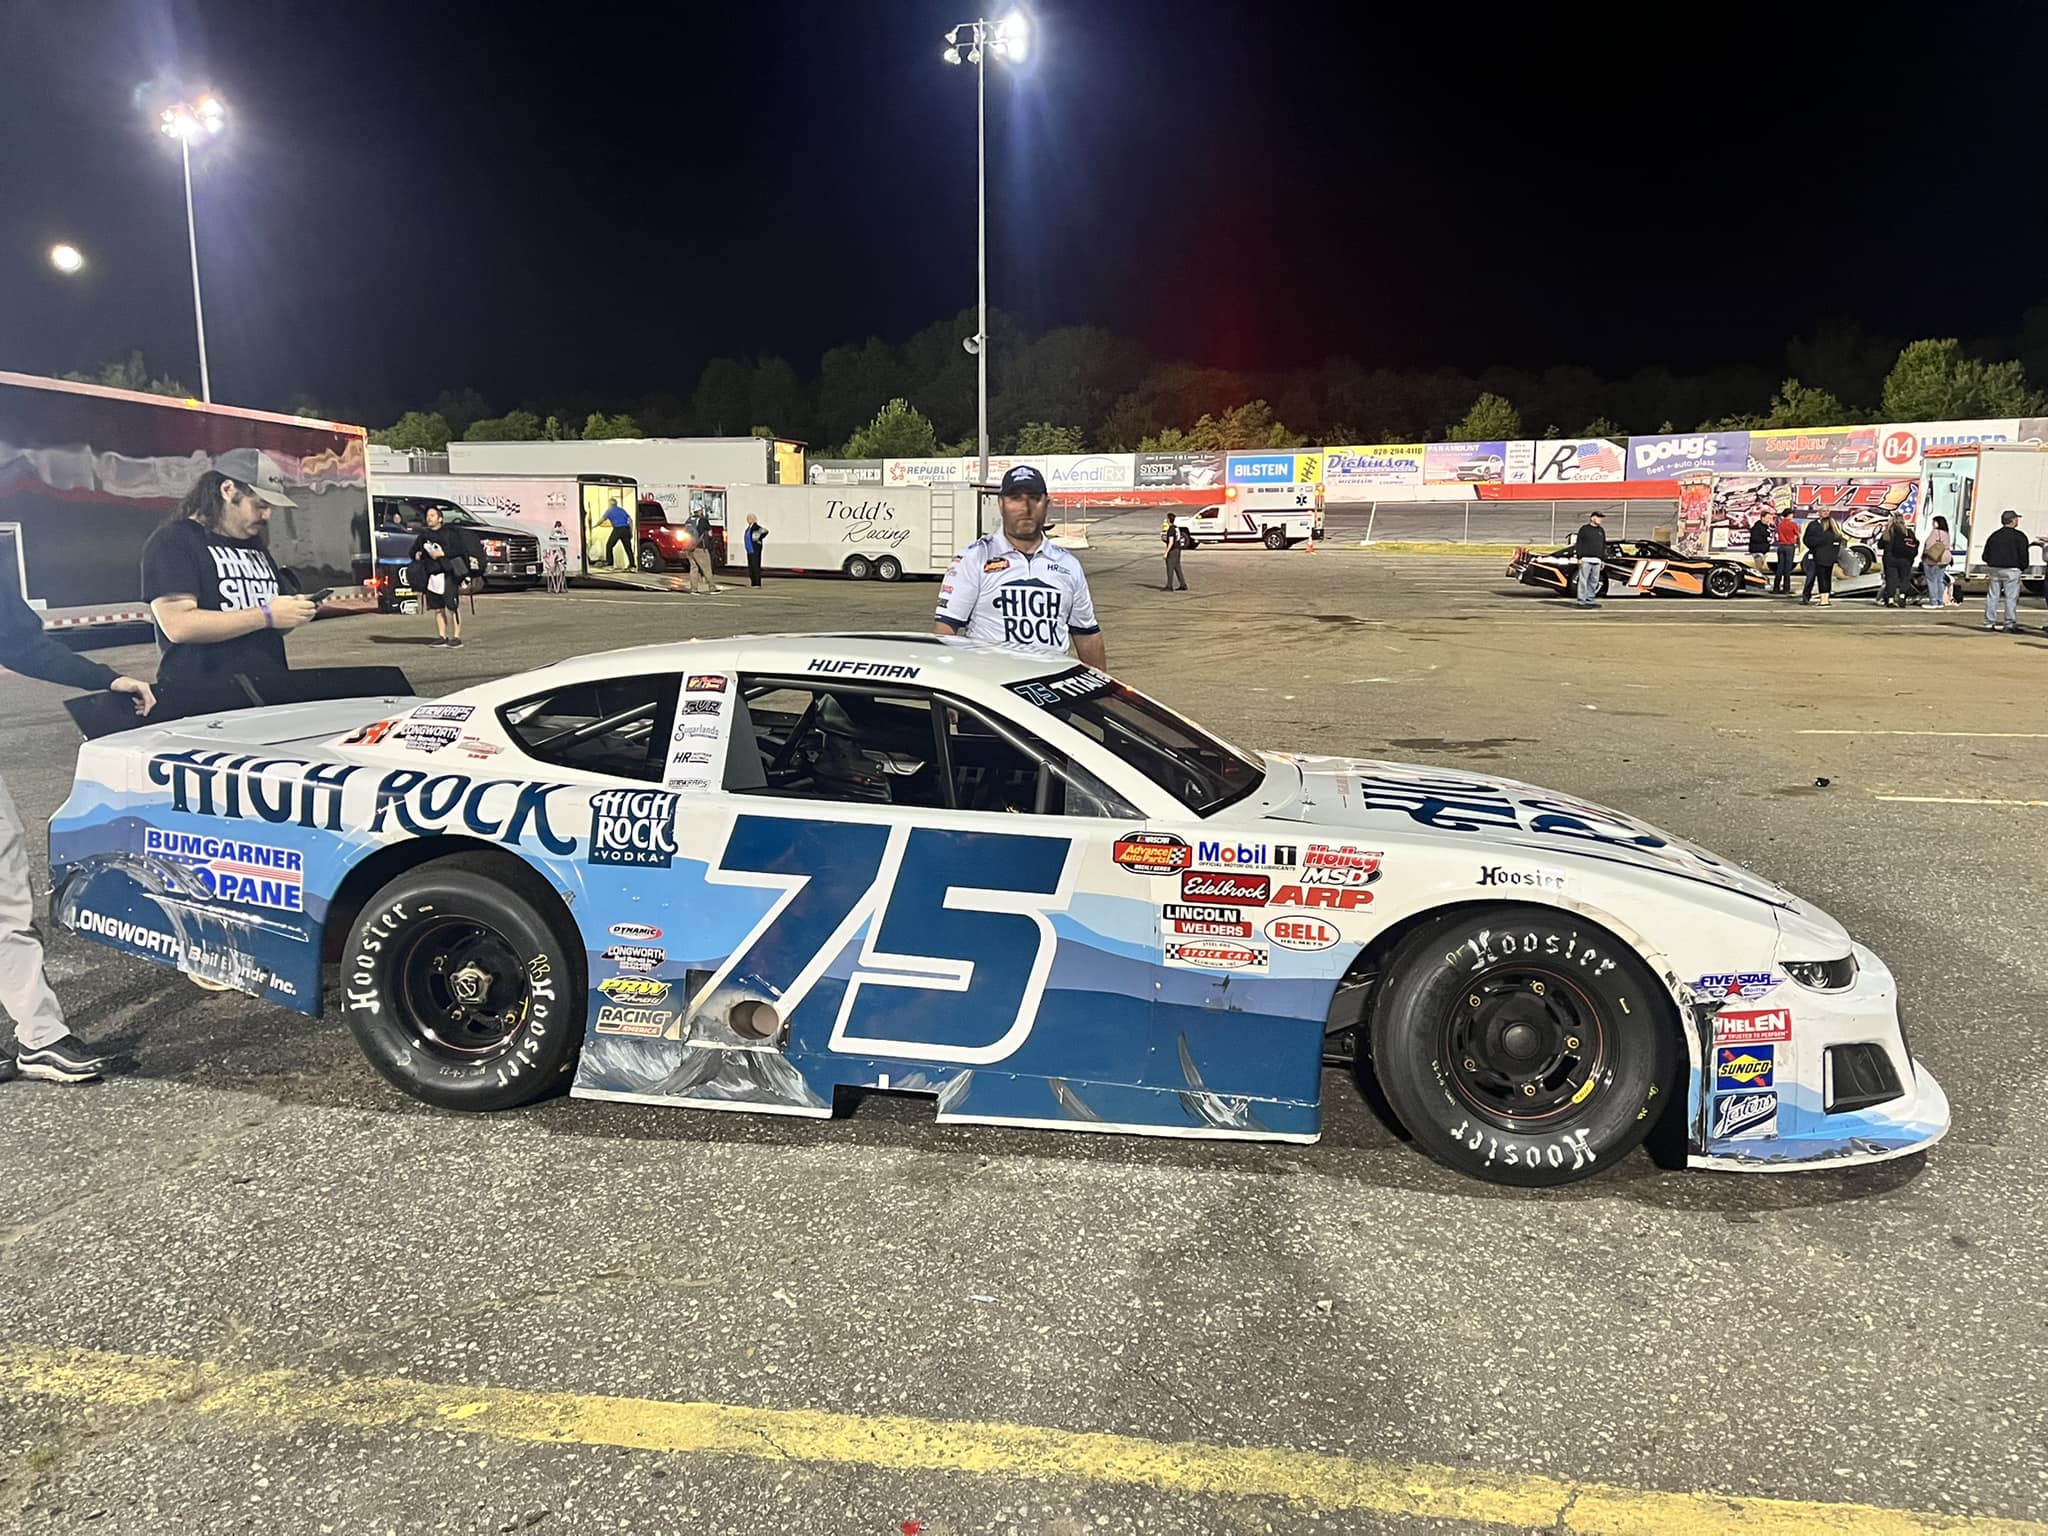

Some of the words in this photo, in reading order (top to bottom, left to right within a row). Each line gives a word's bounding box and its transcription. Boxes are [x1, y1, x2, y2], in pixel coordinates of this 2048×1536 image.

[1635, 435, 1717, 469] Doug's
[1885, 437, 1913, 459] 84
[907, 466, 956, 475] REPUBLIC
[1140, 464, 1177, 474] SYSTEL
[1234, 463, 1288, 477] BILSTEIN
[1328, 455, 1415, 469] Dickinson
[826, 500, 895, 520] Todd's
[842, 521, 910, 548] Racing
[1627, 560, 1670, 588] 17
[993, 589, 1061, 619] HIGH
[1004, 618, 1064, 647] ROCK
[807, 659, 921, 679] HUFFMAN
[1013, 682, 1061, 706] 75
[401, 725, 460, 740] LONGWORTH
[674, 723, 719, 742] Sugarlands
[673, 752, 692, 764] HR
[149, 750, 366, 832] HIGH
[369, 770, 577, 856] ROCK
[591, 791, 676, 819] HIGH
[596, 816, 676, 852] ROCK
[148, 831, 302, 871] BUMGARNER
[601, 851, 659, 863] VODKA
[1118, 853, 1142, 862] Auto
[1142, 854, 1167, 864] Parts
[1125, 845, 1169, 856] Advance
[1199, 842, 1267, 864] Mobil
[1304, 844, 1379, 873] Holley
[1301, 869, 1369, 886] MSD
[1475, 865, 1565, 889] Hoosier
[1183, 877, 1267, 900] Edelbrock
[1270, 885, 1374, 909] ARP
[1166, 906, 1238, 922] LINCOLN
[613, 926, 657, 936] DYNAMIC
[690, 812, 1082, 1062] 75
[1181, 922, 1244, 937] WELDERS
[1274, 922, 1330, 941] BELL
[348, 902, 409, 1014] Hoosier
[608, 945, 666, 960] LONGWORTH
[1184, 949, 1221, 958] STOCK
[1227, 952, 1251, 961] CAR
[1467, 930, 1617, 976] Hoosier
[269, 973, 297, 995] Inc.
[599, 979, 668, 995] PRW
[1701, 974, 1735, 988] FIVE
[1738, 973, 1772, 986] STAR
[601, 1008, 665, 1025] RACING
[1712, 1011, 1786, 1033] WHELEN
[497, 973, 556, 1087] Hoosier
[1720, 1061, 1770, 1075] SUNOCO
[1450, 1120, 1597, 1170] Hoosier
